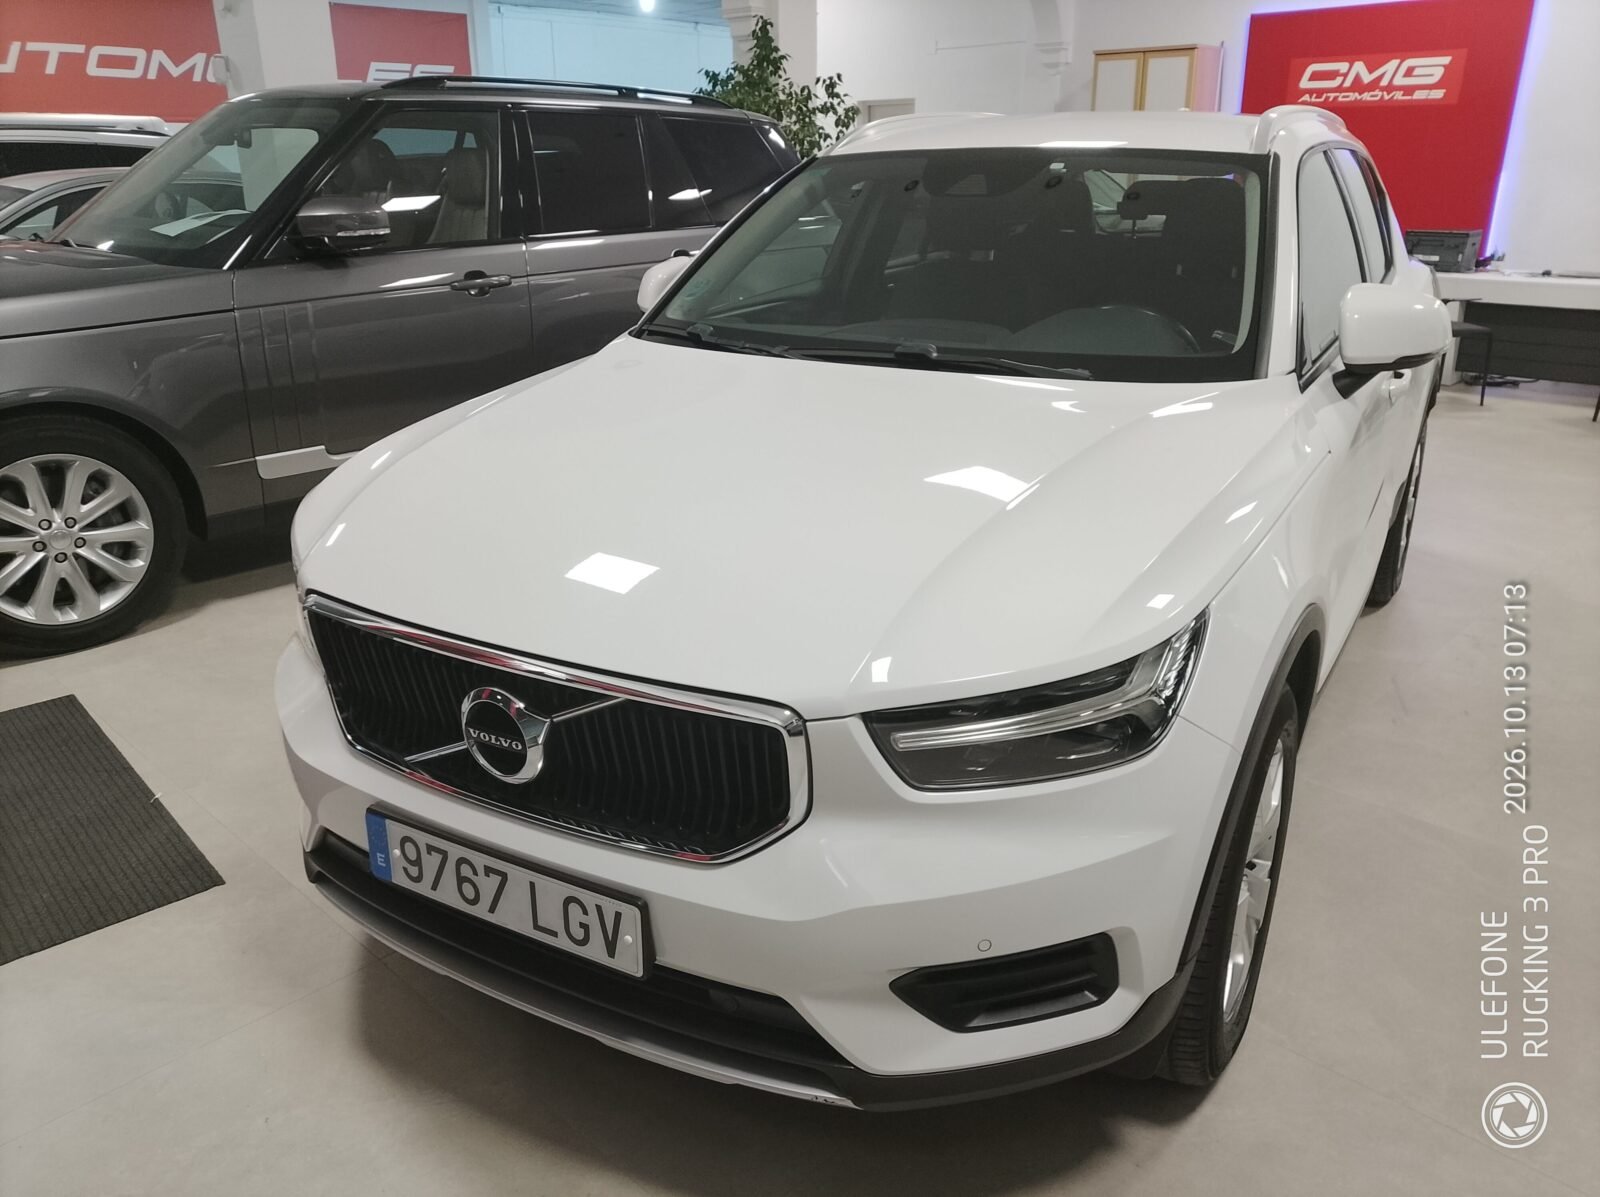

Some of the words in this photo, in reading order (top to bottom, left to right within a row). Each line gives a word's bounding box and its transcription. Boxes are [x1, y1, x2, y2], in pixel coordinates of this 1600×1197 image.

[1299, 56, 1452, 89] CMG
[1298, 89, 1446, 103] AUTOMÓVILES
[468, 727, 522, 750] VOLVO
[376, 852, 386, 867] E
[400, 835, 508, 914] 9767
[529, 880, 622, 959] LGV
